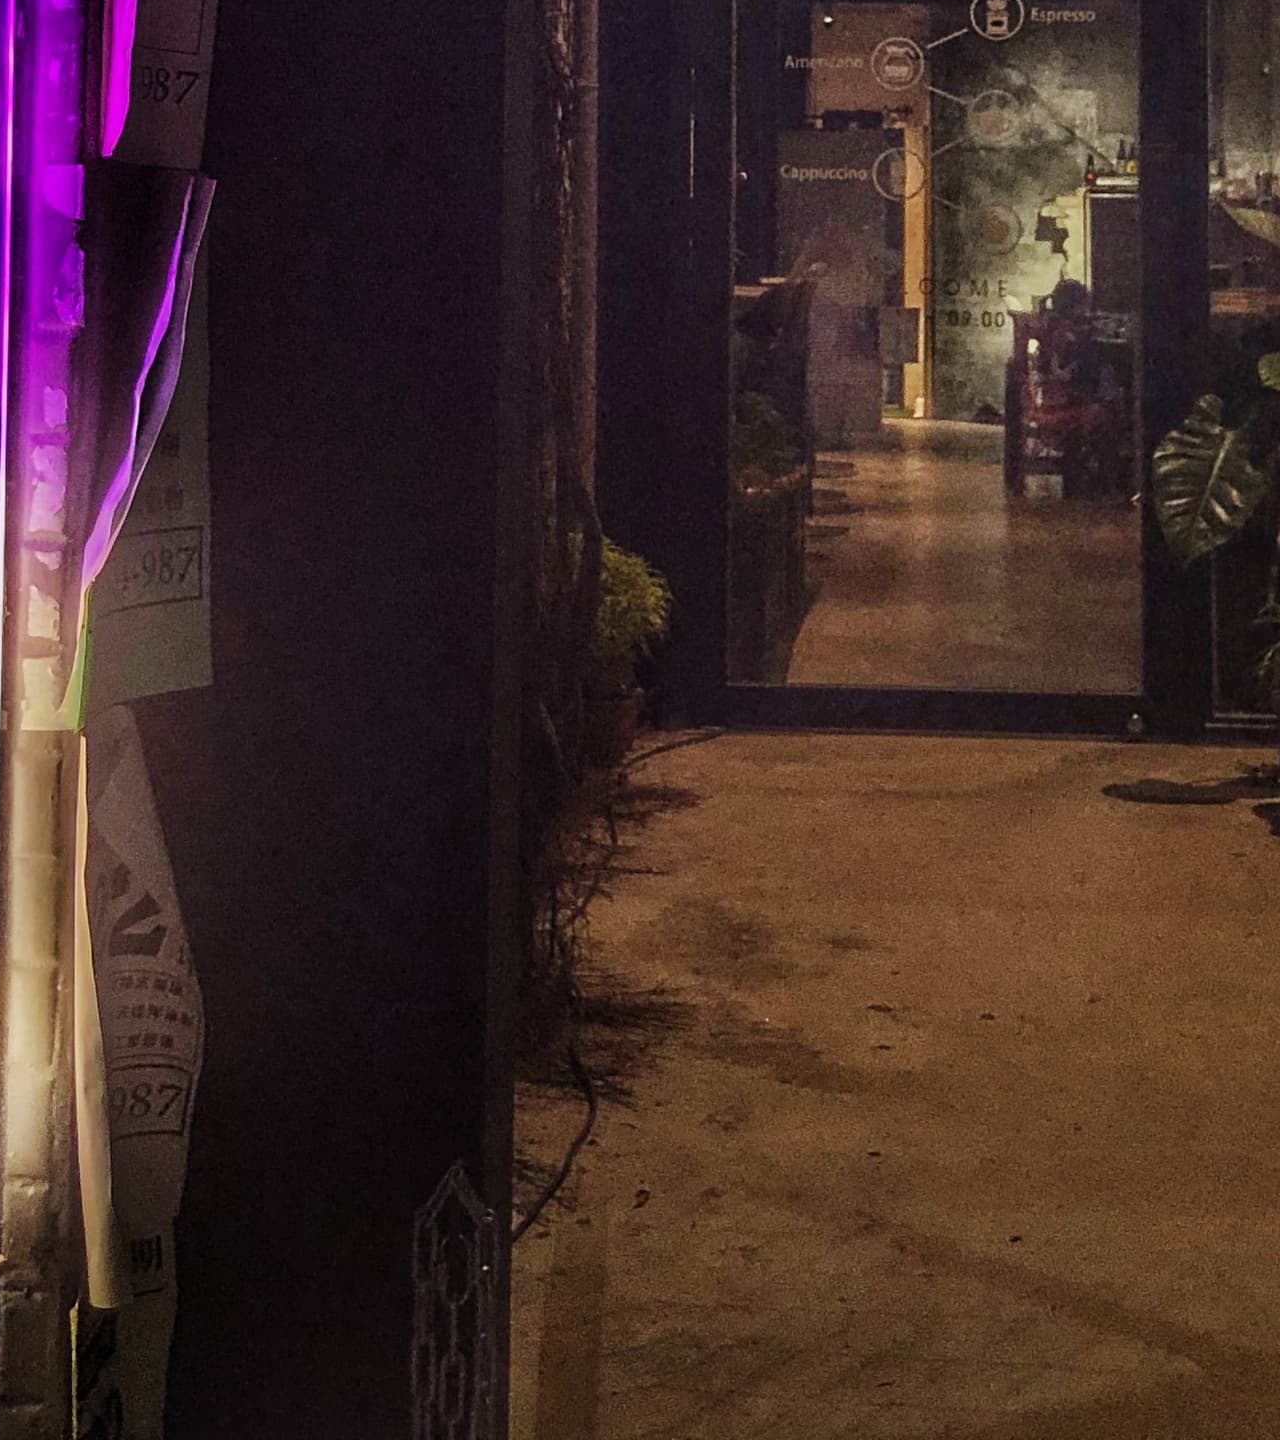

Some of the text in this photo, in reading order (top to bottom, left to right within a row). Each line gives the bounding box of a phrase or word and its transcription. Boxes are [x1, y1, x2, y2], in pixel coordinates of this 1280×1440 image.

[1030, 7, 1097, 24] Espresso
[783, 54, 864, 70] Americano
[780, 164, 868, 182] Cappuccino
